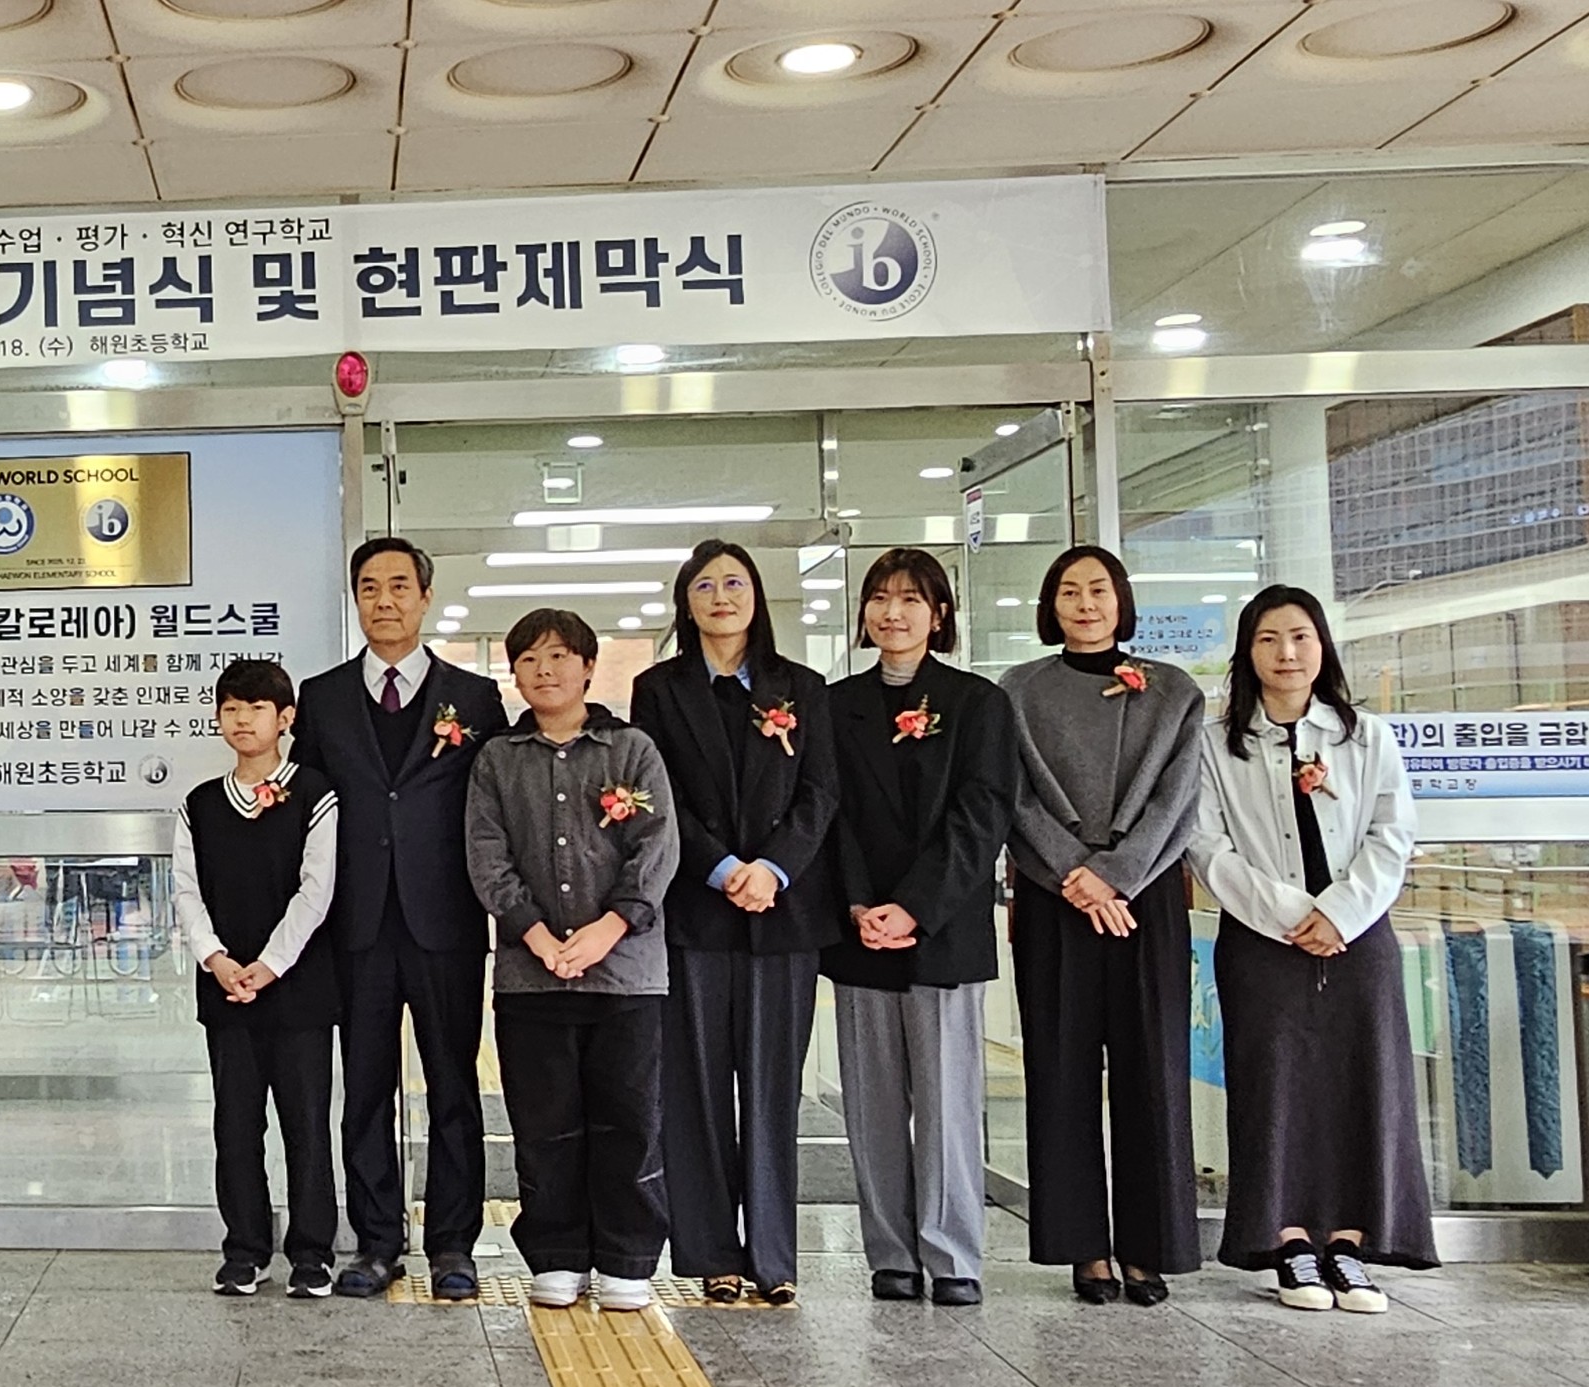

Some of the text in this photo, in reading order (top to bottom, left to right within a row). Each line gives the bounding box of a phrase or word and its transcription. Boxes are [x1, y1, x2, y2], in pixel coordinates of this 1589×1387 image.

[832, 206, 870, 227] MUNDO
[76, 223, 129, 252] 평가
[161, 220, 213, 249] 혁신
[224, 217, 333, 248] 연구학교
[882, 207, 932, 270] WORLD SCHOOL
[252, 250, 320, 322] 및
[352, 234, 745, 319] 현판제막식
[0, 338, 30, 357] 18.
[38, 336, 74, 358] (수)
[89, 332, 210, 355] 해원초등학교
[63, 467, 140, 483] SCHOOL
[149, 602, 281, 638] 월드스쿨
[0, 655, 54, 676] 관심을
[61, 655, 98, 674] 두고
[104, 653, 158, 673] 세계를
[166, 653, 202, 673] 함께
[31, 687, 85, 707] 소양을
[92, 687, 129, 706] 갖춘
[136, 686, 190, 706] 인재로
[59, 719, 114, 740] 만들어
[121, 718, 158, 739] 나갈
[163, 718, 182, 738] 수
[1453, 721, 1530, 748] 출입을
[1538, 721, 1589, 748] 금합
